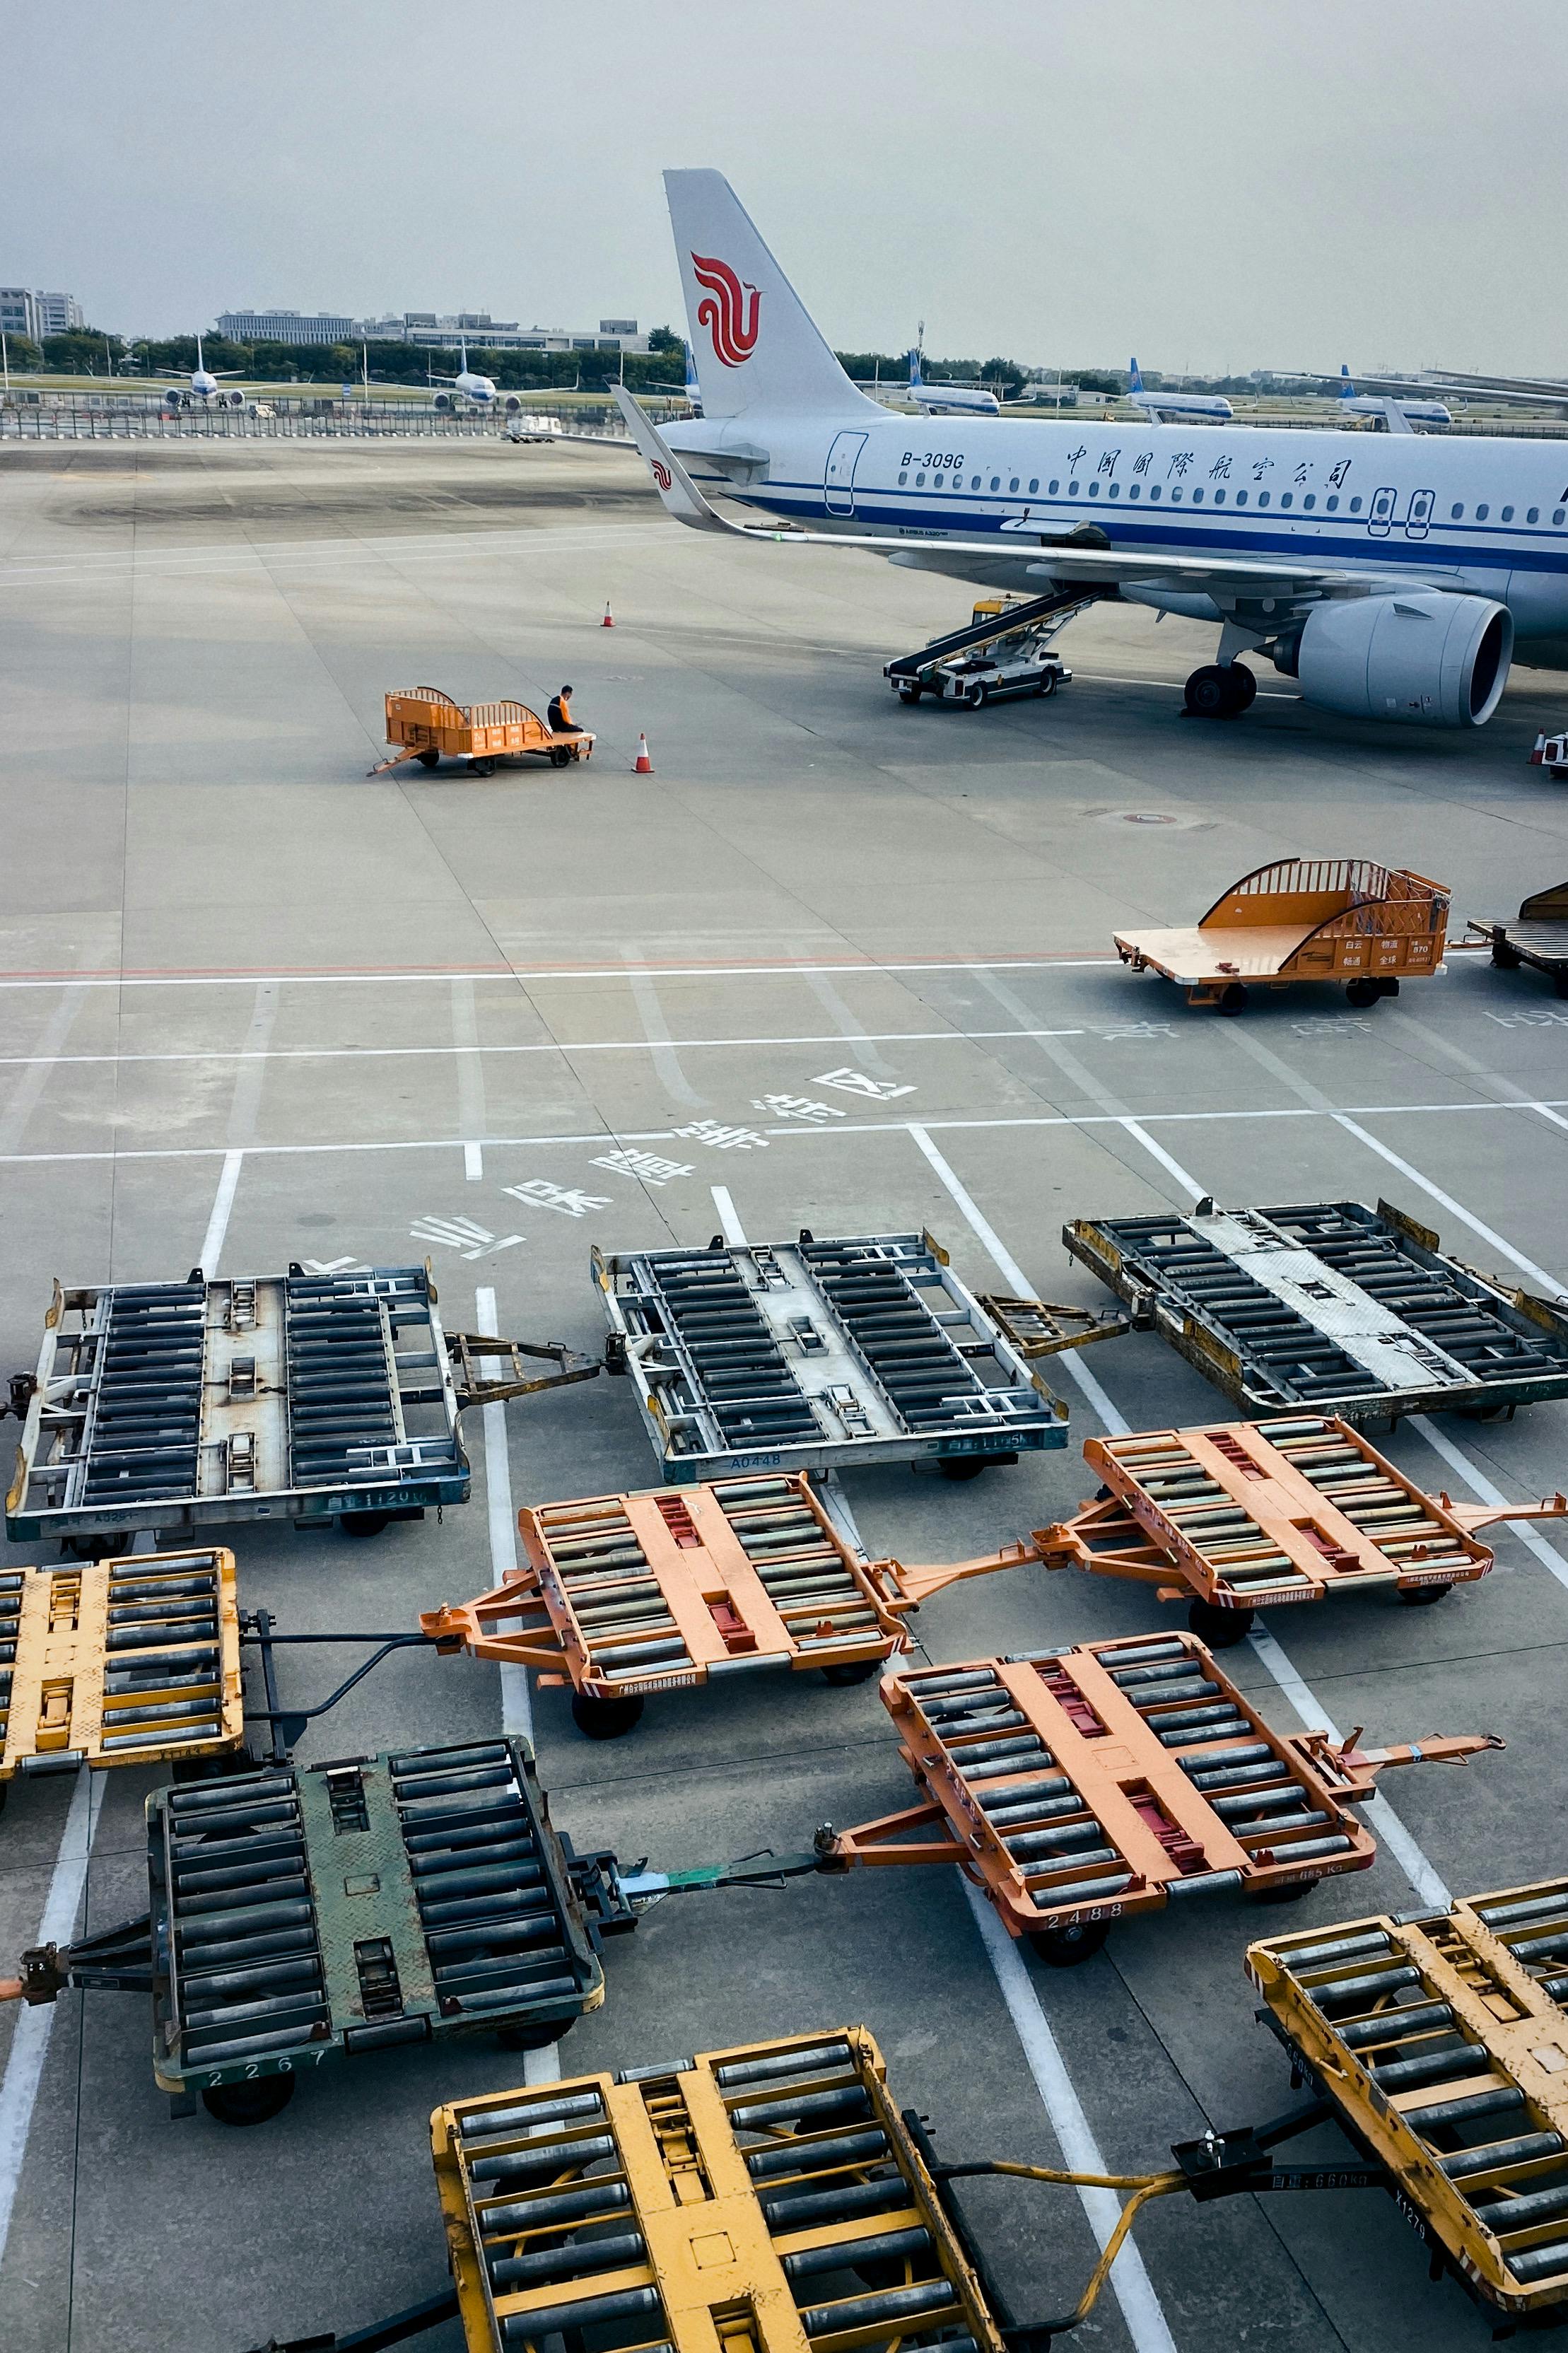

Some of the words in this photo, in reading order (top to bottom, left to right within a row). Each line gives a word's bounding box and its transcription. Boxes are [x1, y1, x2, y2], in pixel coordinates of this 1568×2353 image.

[901, 452, 964, 469] B-309G
[730, 1454, 780, 1469] A0448
[1299, 1869, 1323, 1880] 685
[1048, 1903, 1122, 1929] 2488
[209, 2049, 325, 2086] 2267
[1396, 2190, 1425, 2239] X1279
